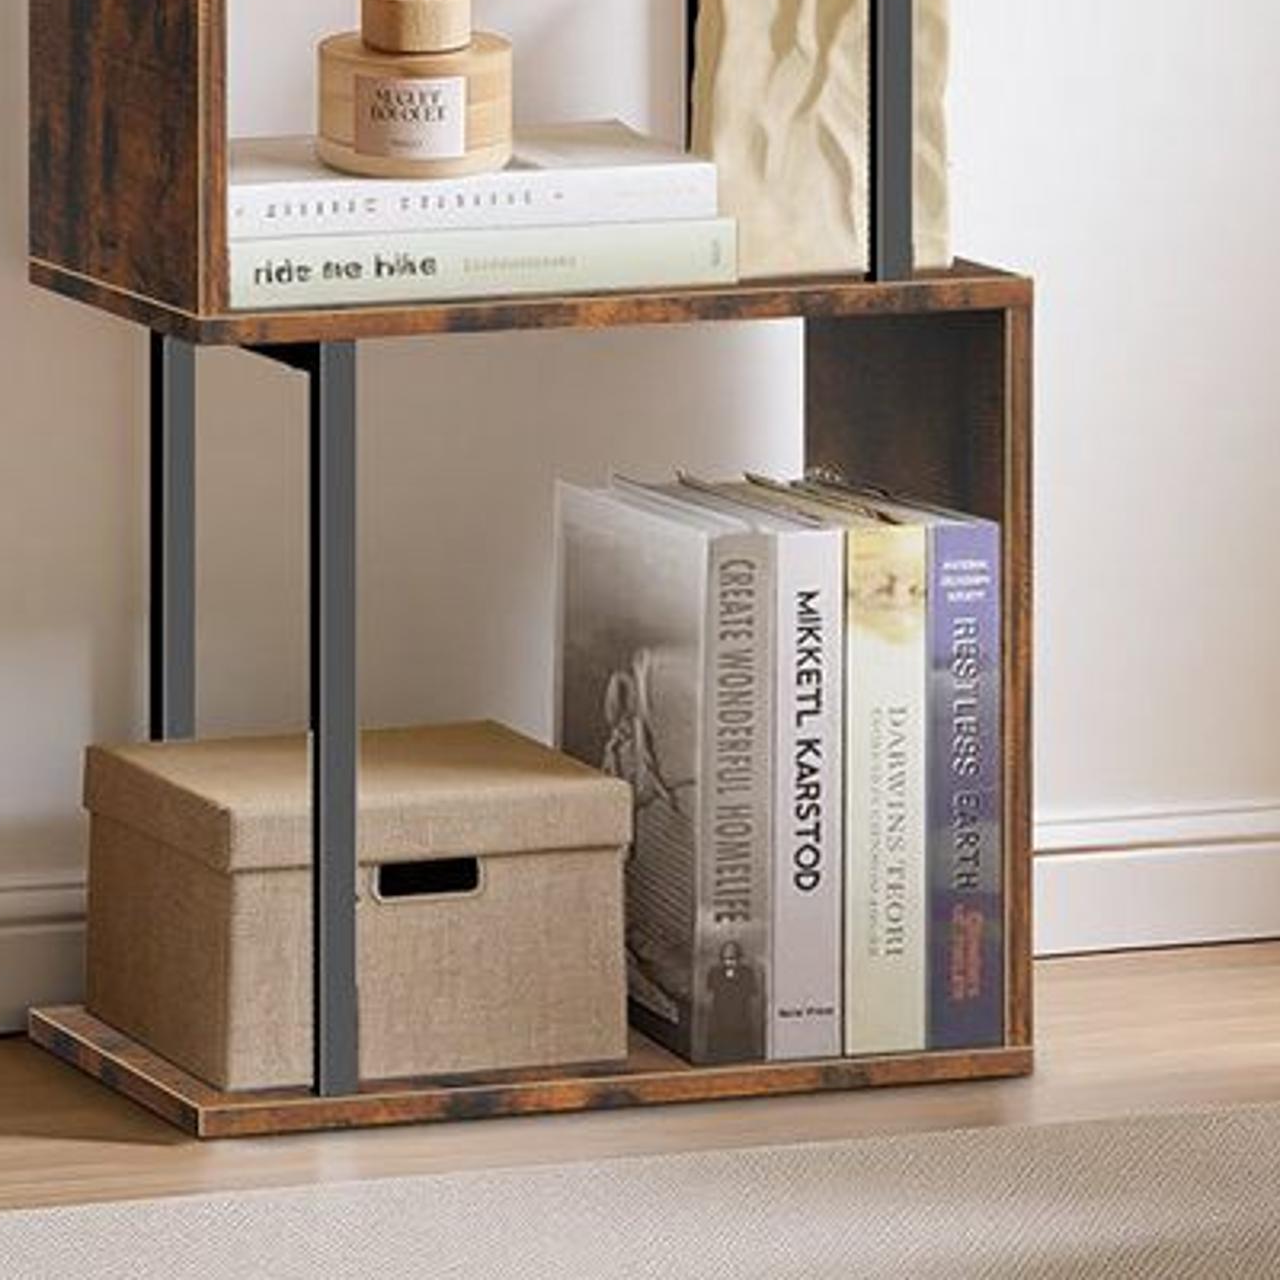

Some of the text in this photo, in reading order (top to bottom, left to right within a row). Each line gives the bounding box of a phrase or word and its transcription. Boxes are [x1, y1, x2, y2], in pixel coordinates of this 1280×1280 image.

[713, 558, 756, 924] CREATE WONDERFUL HOMELIFE
[793, 590, 822, 892] MIKKETL KARSTOD
[950, 616, 978, 778] RESTLESS
[953, 793, 979, 890] EARTH
